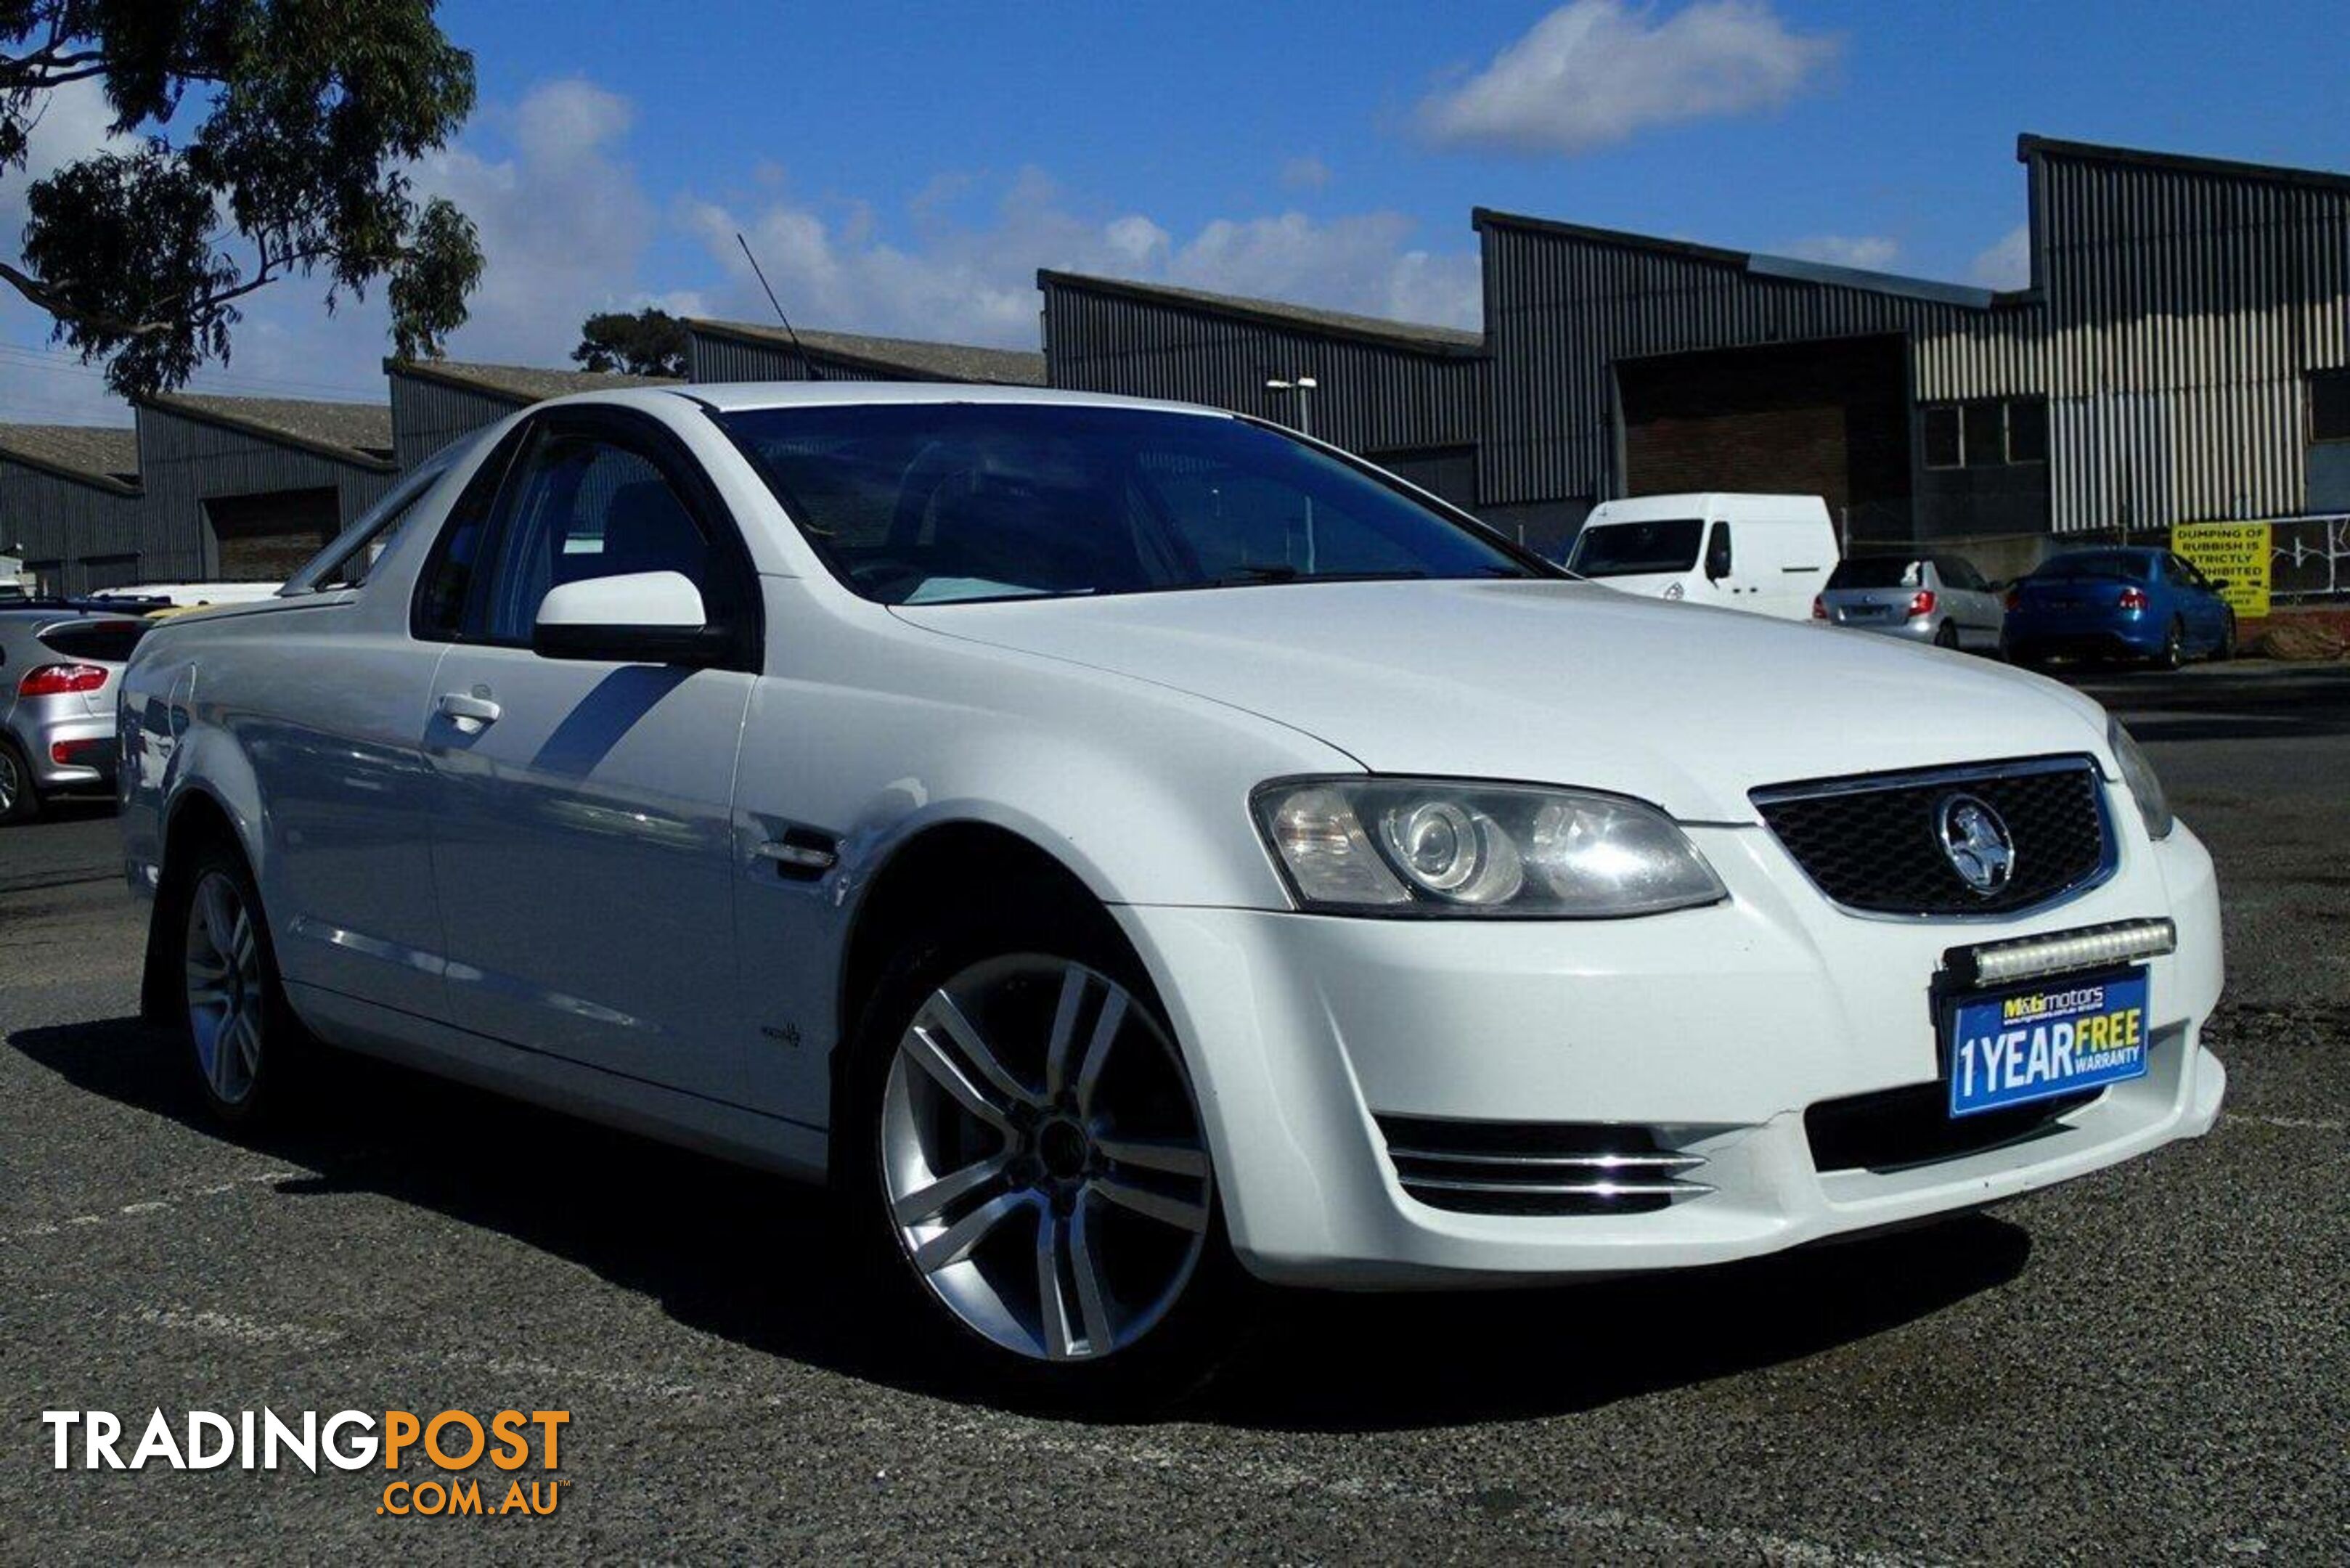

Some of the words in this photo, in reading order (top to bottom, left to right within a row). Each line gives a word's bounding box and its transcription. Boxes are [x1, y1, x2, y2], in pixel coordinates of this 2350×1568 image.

[2178, 529, 2241, 539] DUMPING
[2245, 529, 2264, 538] OF
[2183, 542, 2243, 551] RUBBISH
[2247, 542, 2259, 550] IS
[2190, 554, 2251, 563] STRICTLY
[1960, 1039, 1975, 1097] 1
[1980, 1022, 2075, 1093] YEAR
[2075, 1008, 2141, 1056] FREE
[2075, 1045, 2139, 1074] WARRANTY
